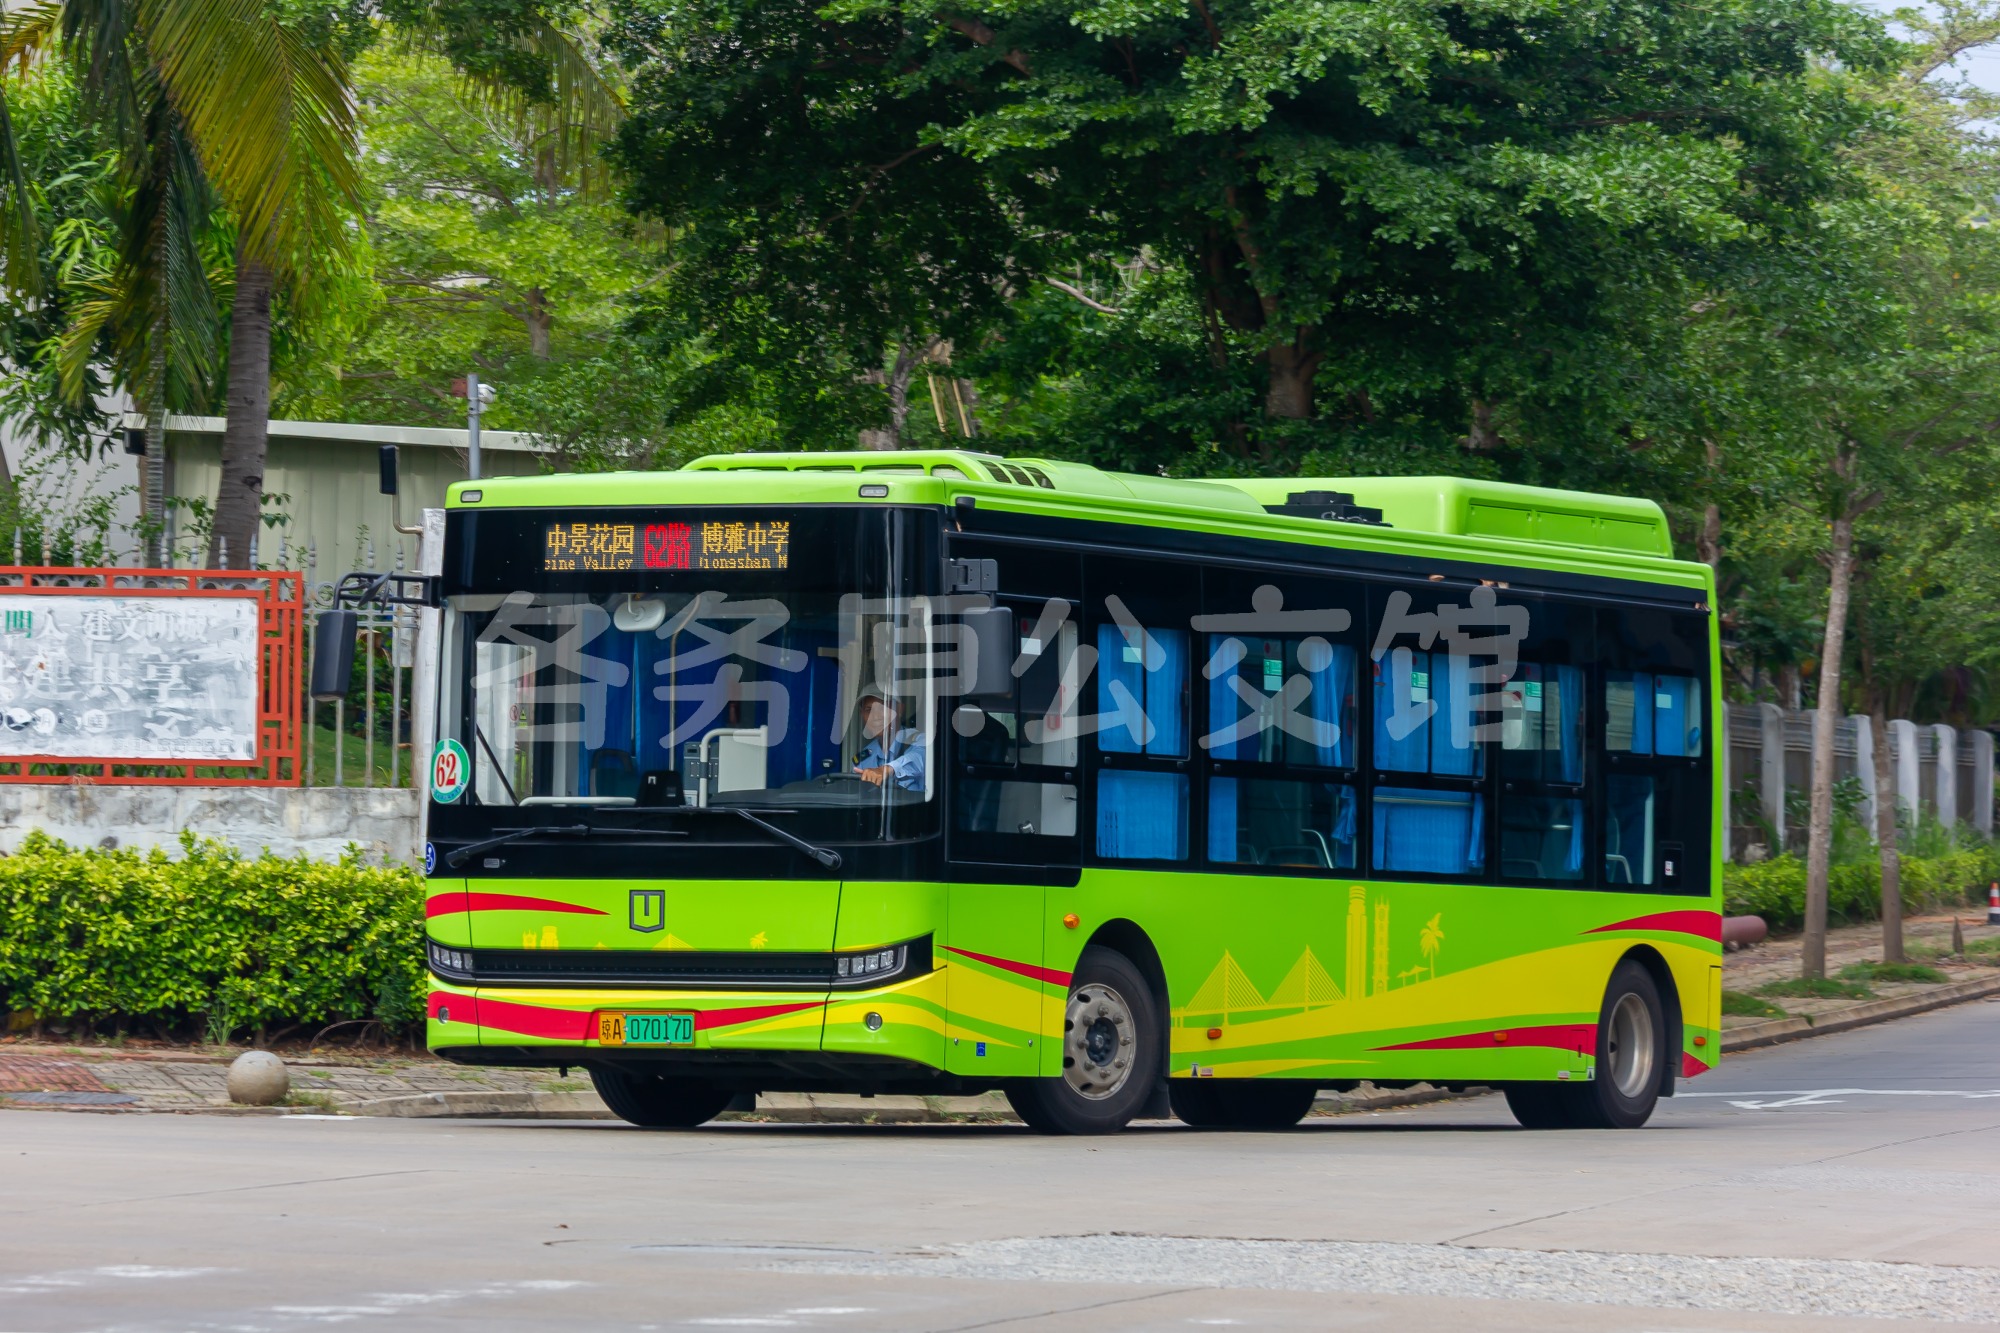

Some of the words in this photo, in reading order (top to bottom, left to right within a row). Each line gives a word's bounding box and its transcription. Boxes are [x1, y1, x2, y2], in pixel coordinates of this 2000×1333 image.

[547, 523, 635, 556] 中景花园
[644, 522, 691, 569] 62路
[701, 521, 789, 555] 博雅中学
[583, 554, 634, 570] Valley
[436, 753, 457, 787] 62
